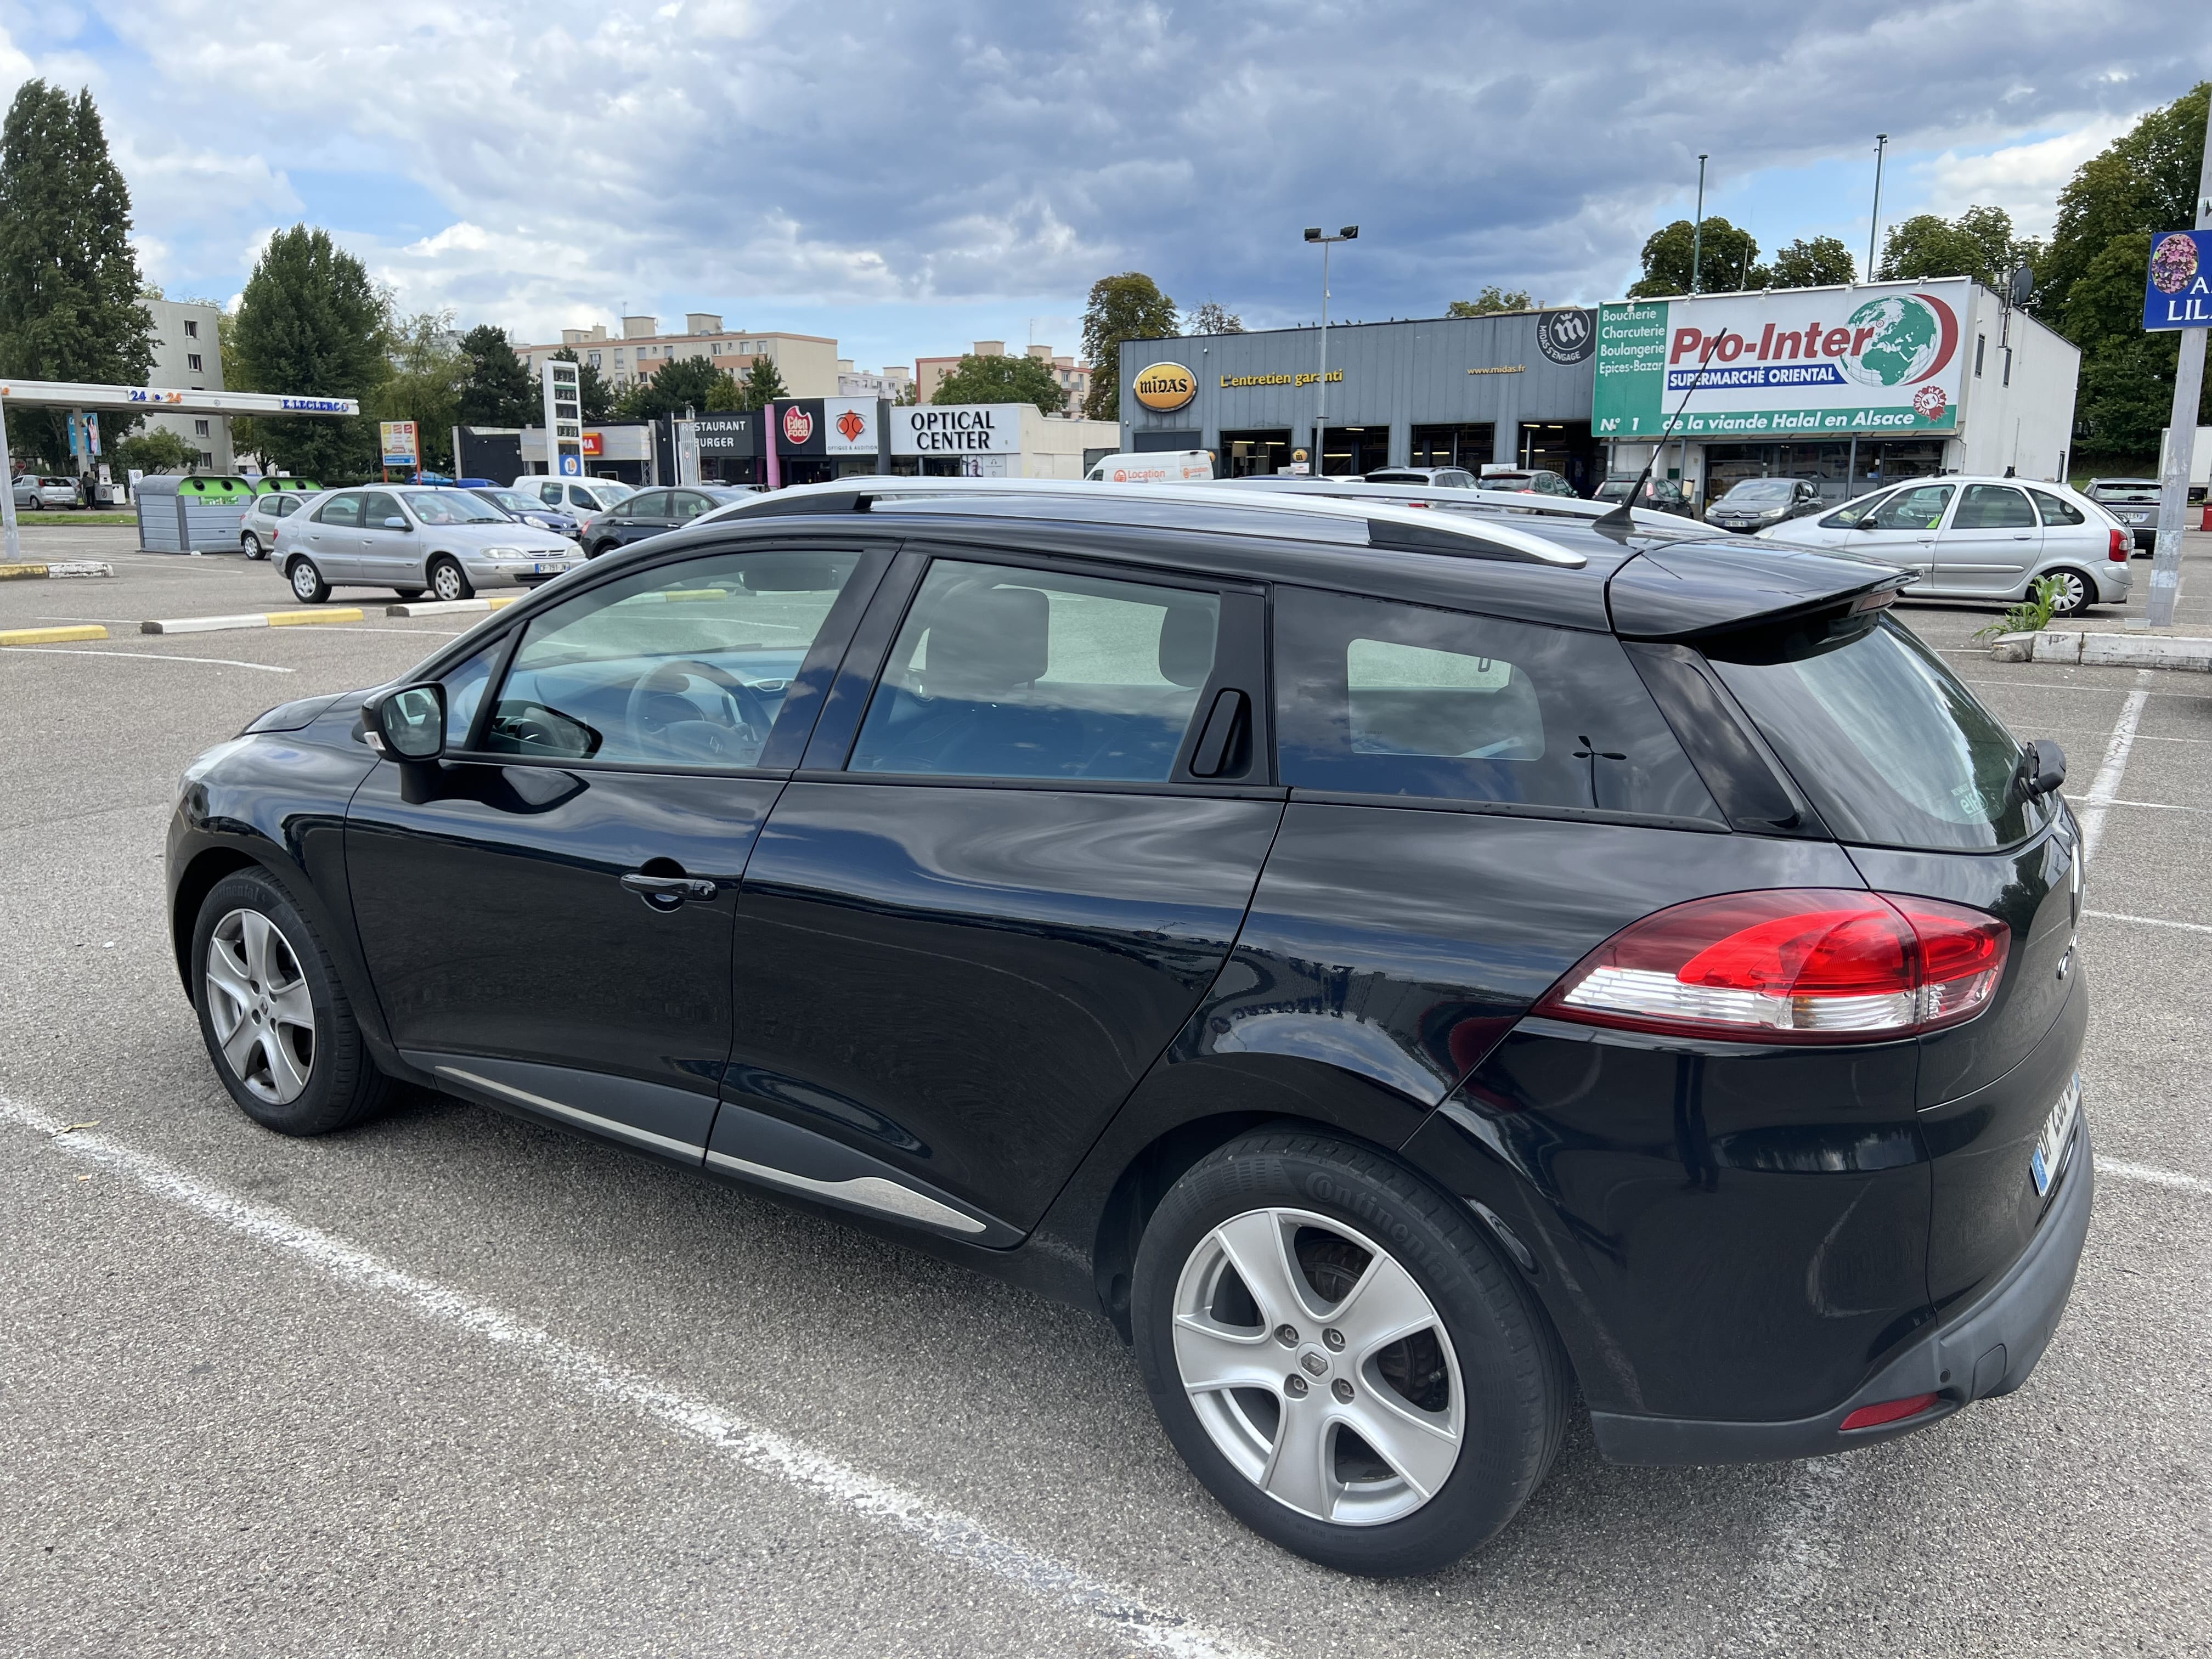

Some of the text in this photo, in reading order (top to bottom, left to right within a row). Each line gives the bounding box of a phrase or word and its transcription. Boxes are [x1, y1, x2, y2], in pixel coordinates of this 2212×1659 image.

[2190, 277, 2212, 294] A
[1602, 307, 1656, 321] Boucherie
[1602, 324, 1666, 339] Charcuterie
[1539, 325, 1581, 362] MIDAS S'ENGAGE
[1600, 341, 1665, 358] Boulangerie
[1669, 322, 1874, 364] Pro-Inter
[1467, 364, 1526, 375] www.midas.fr
[1670, 366, 1835, 387] SUPERMARCHÉ ORIENTAL
[1220, 371, 1291, 387] L'entretien
[130, 391, 182, 403] 24 24
[681, 421, 746, 432] RESTAURANT
[787, 416, 808, 430] Eden
[911, 411, 995, 431] OPTICAL
[1632, 417, 1639, 431] 1
[1662, 415, 1684, 430] de
[1687, 415, 1704, 430] la
[1709, 413, 1768, 429] viande
[1772, 411, 1821, 428] Halal
[1825, 416, 1848, 427] en
[1852, 410, 1915, 426] Alsace
[694, 437, 734, 447] BURGER
[917, 431, 991, 450] CENTER
[1128, 470, 1165, 478] Location
